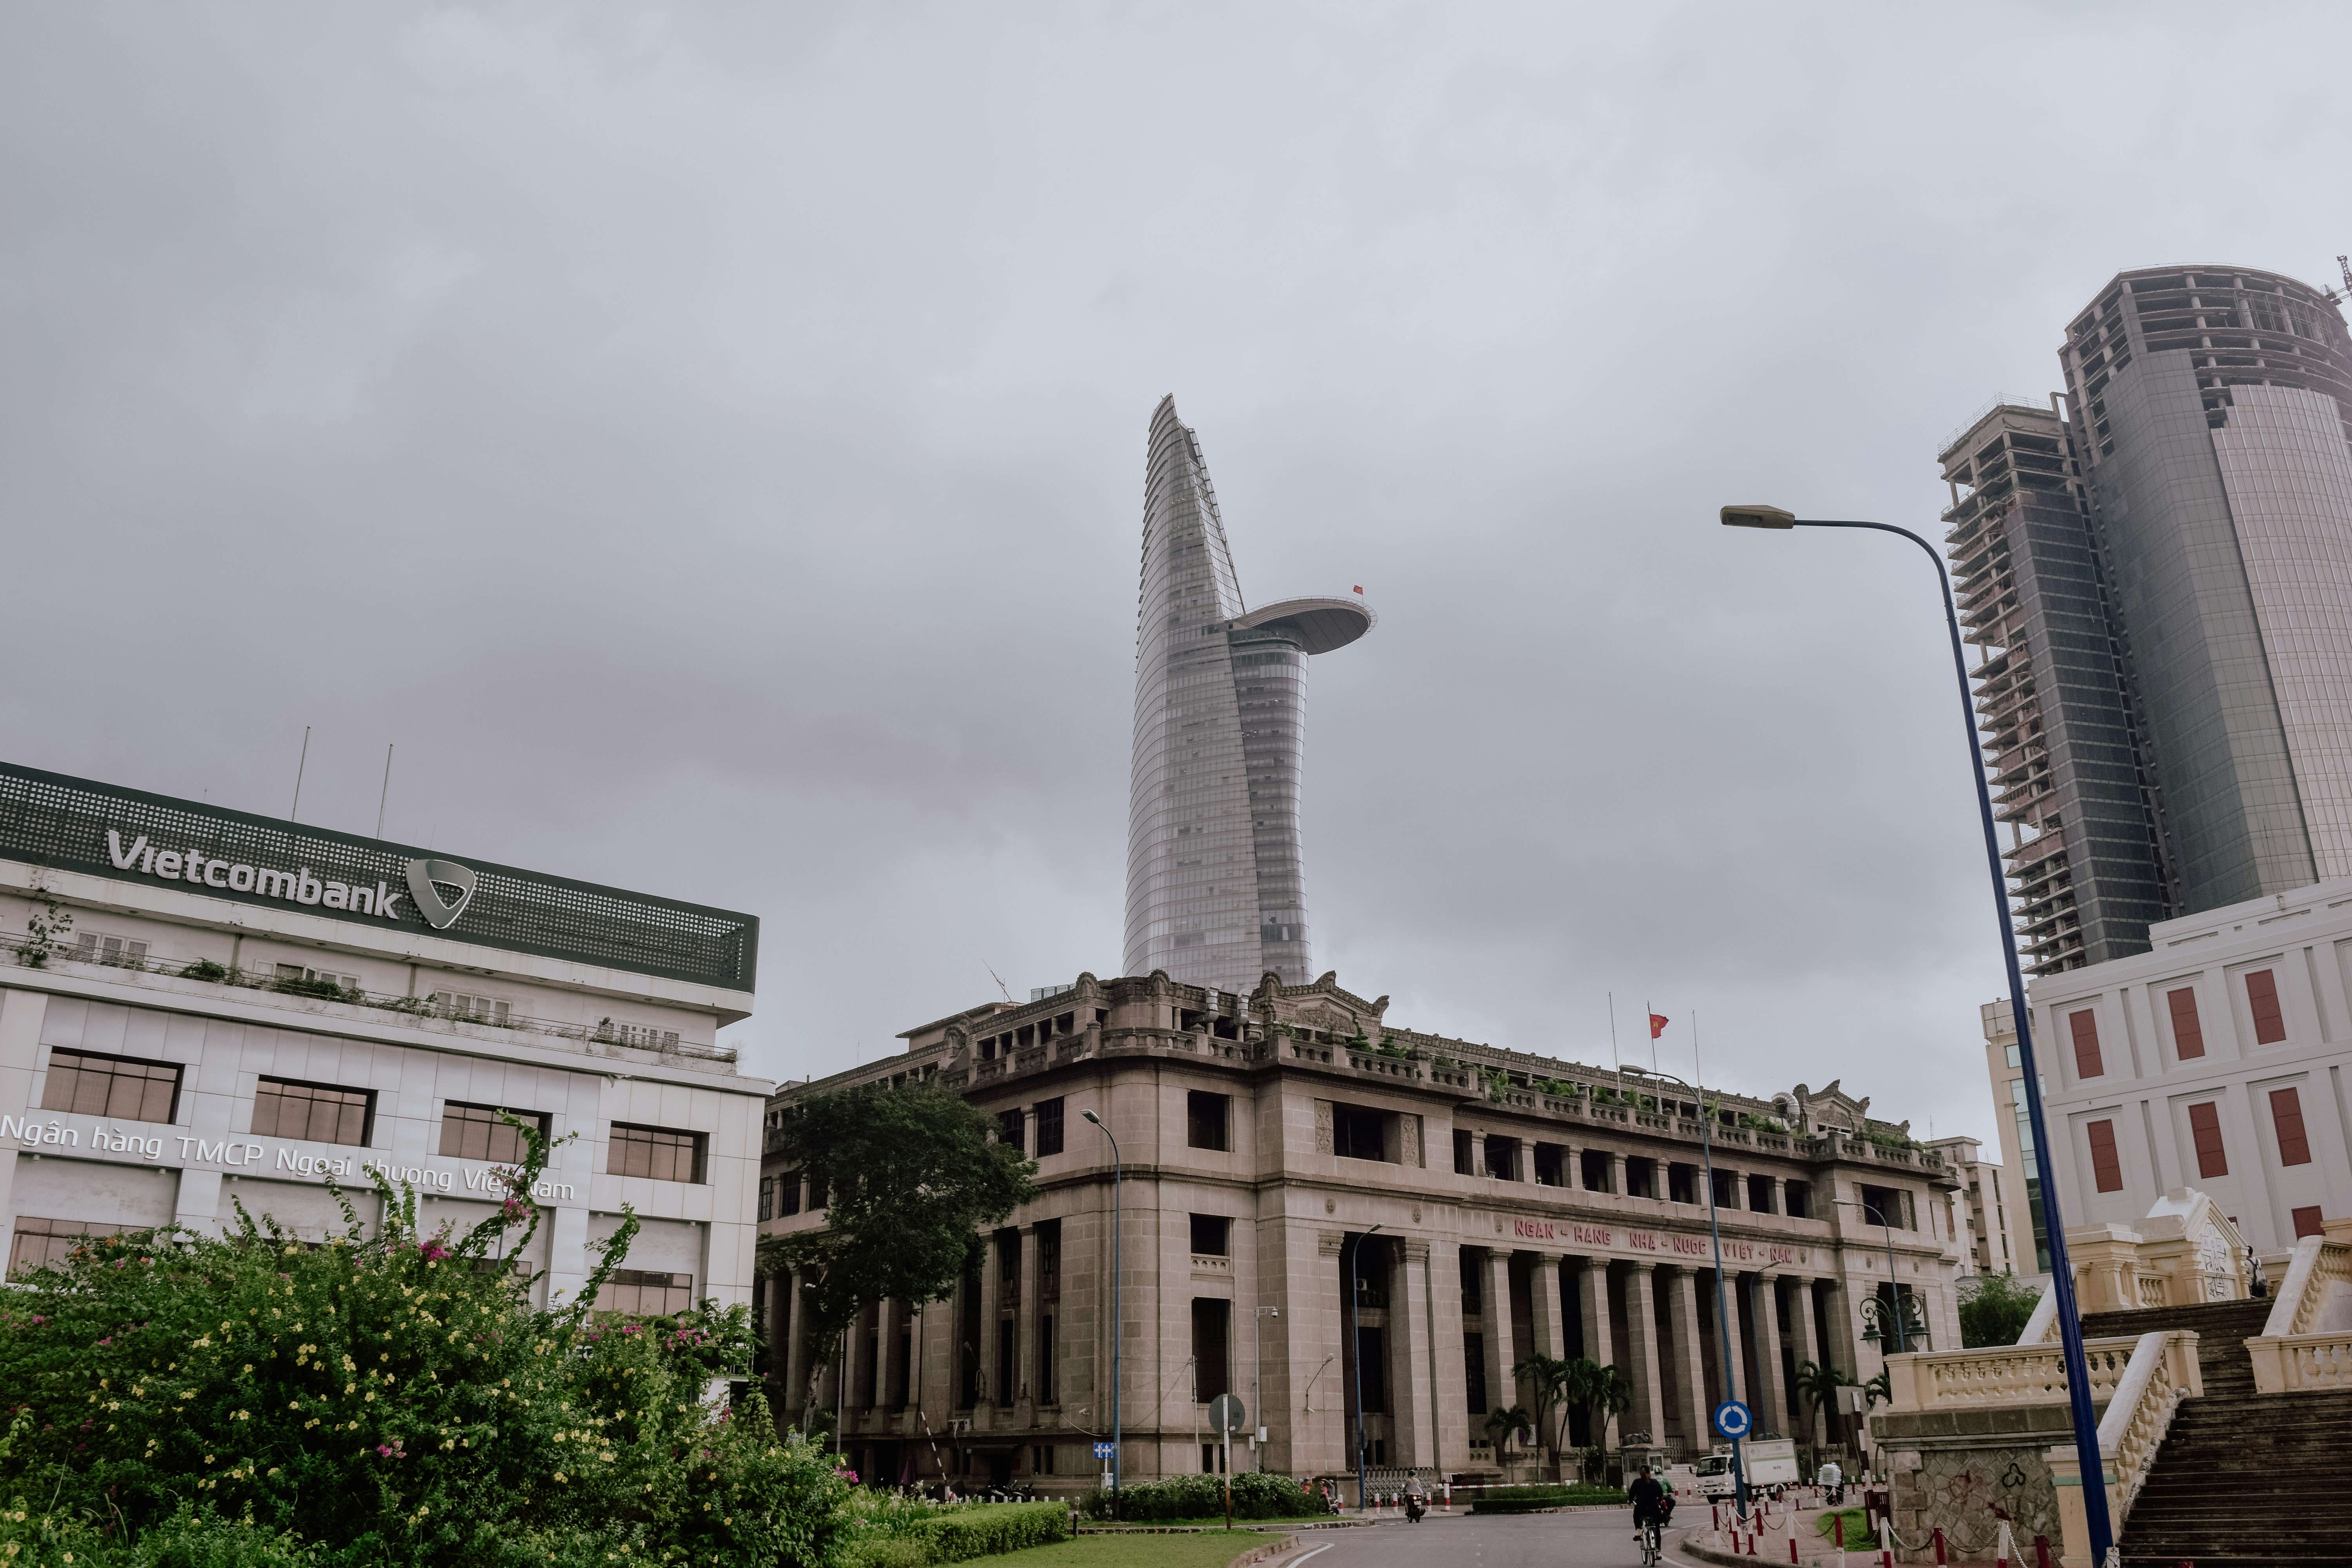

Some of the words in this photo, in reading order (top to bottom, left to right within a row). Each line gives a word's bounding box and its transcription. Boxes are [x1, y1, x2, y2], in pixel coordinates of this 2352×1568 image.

[108, 829, 401, 920] Vietcombank
[0, 1114, 79, 1147] Ngân
[91, 1126, 162, 1160] hàng
[176, 1136, 264, 1166] TMCP
[276, 1148, 352, 1181] Ngoại
